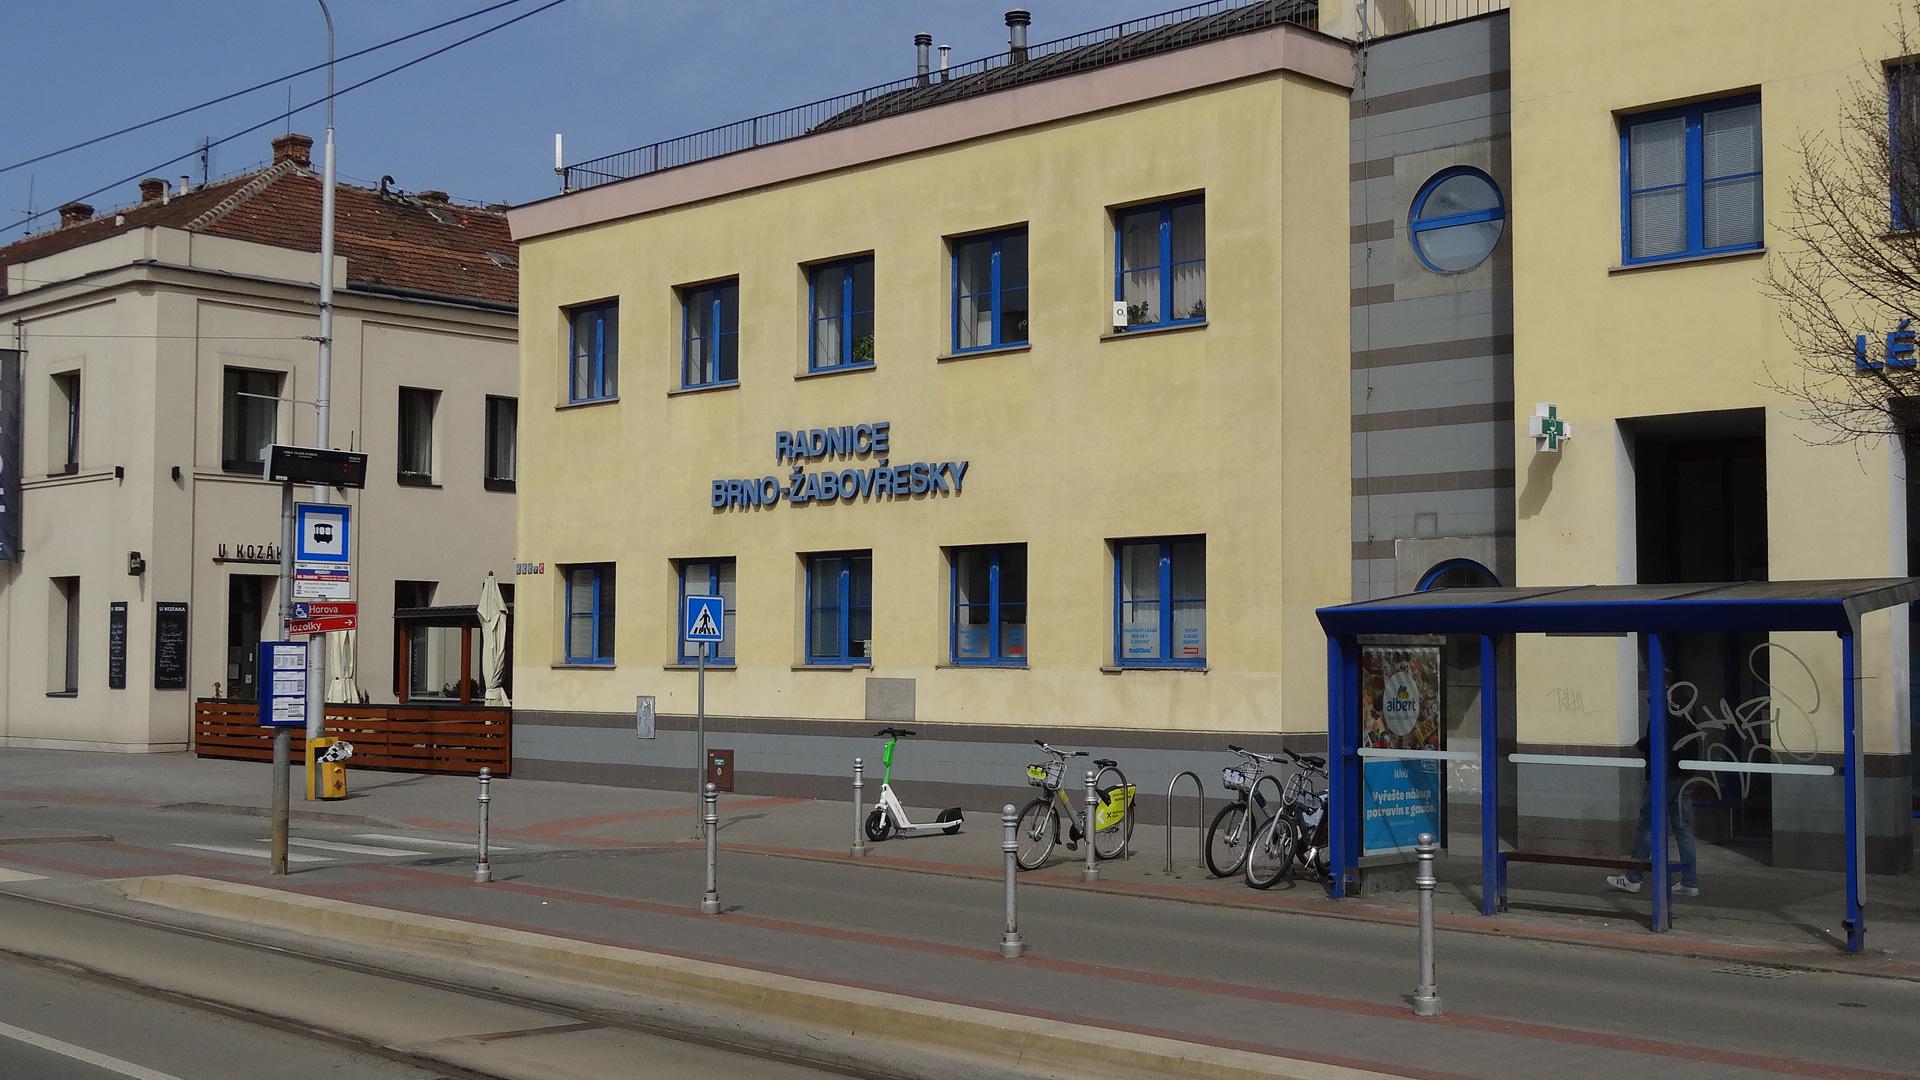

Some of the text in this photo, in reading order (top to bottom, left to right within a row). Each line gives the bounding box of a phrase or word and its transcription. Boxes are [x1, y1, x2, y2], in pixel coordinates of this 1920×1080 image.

[775, 421, 890, 460] RADNICE
[711, 458, 969, 508] BRNO-ŽABOVŘESKY
[218, 543, 226, 558] U
[309, 604, 339, 614] Horova
[1386, 697, 1417, 712] albert
[1372, 788, 1432, 804] Vyřešte nákup
[1366, 804, 1404, 820] potravin
[1404, 806, 1410, 815] z
